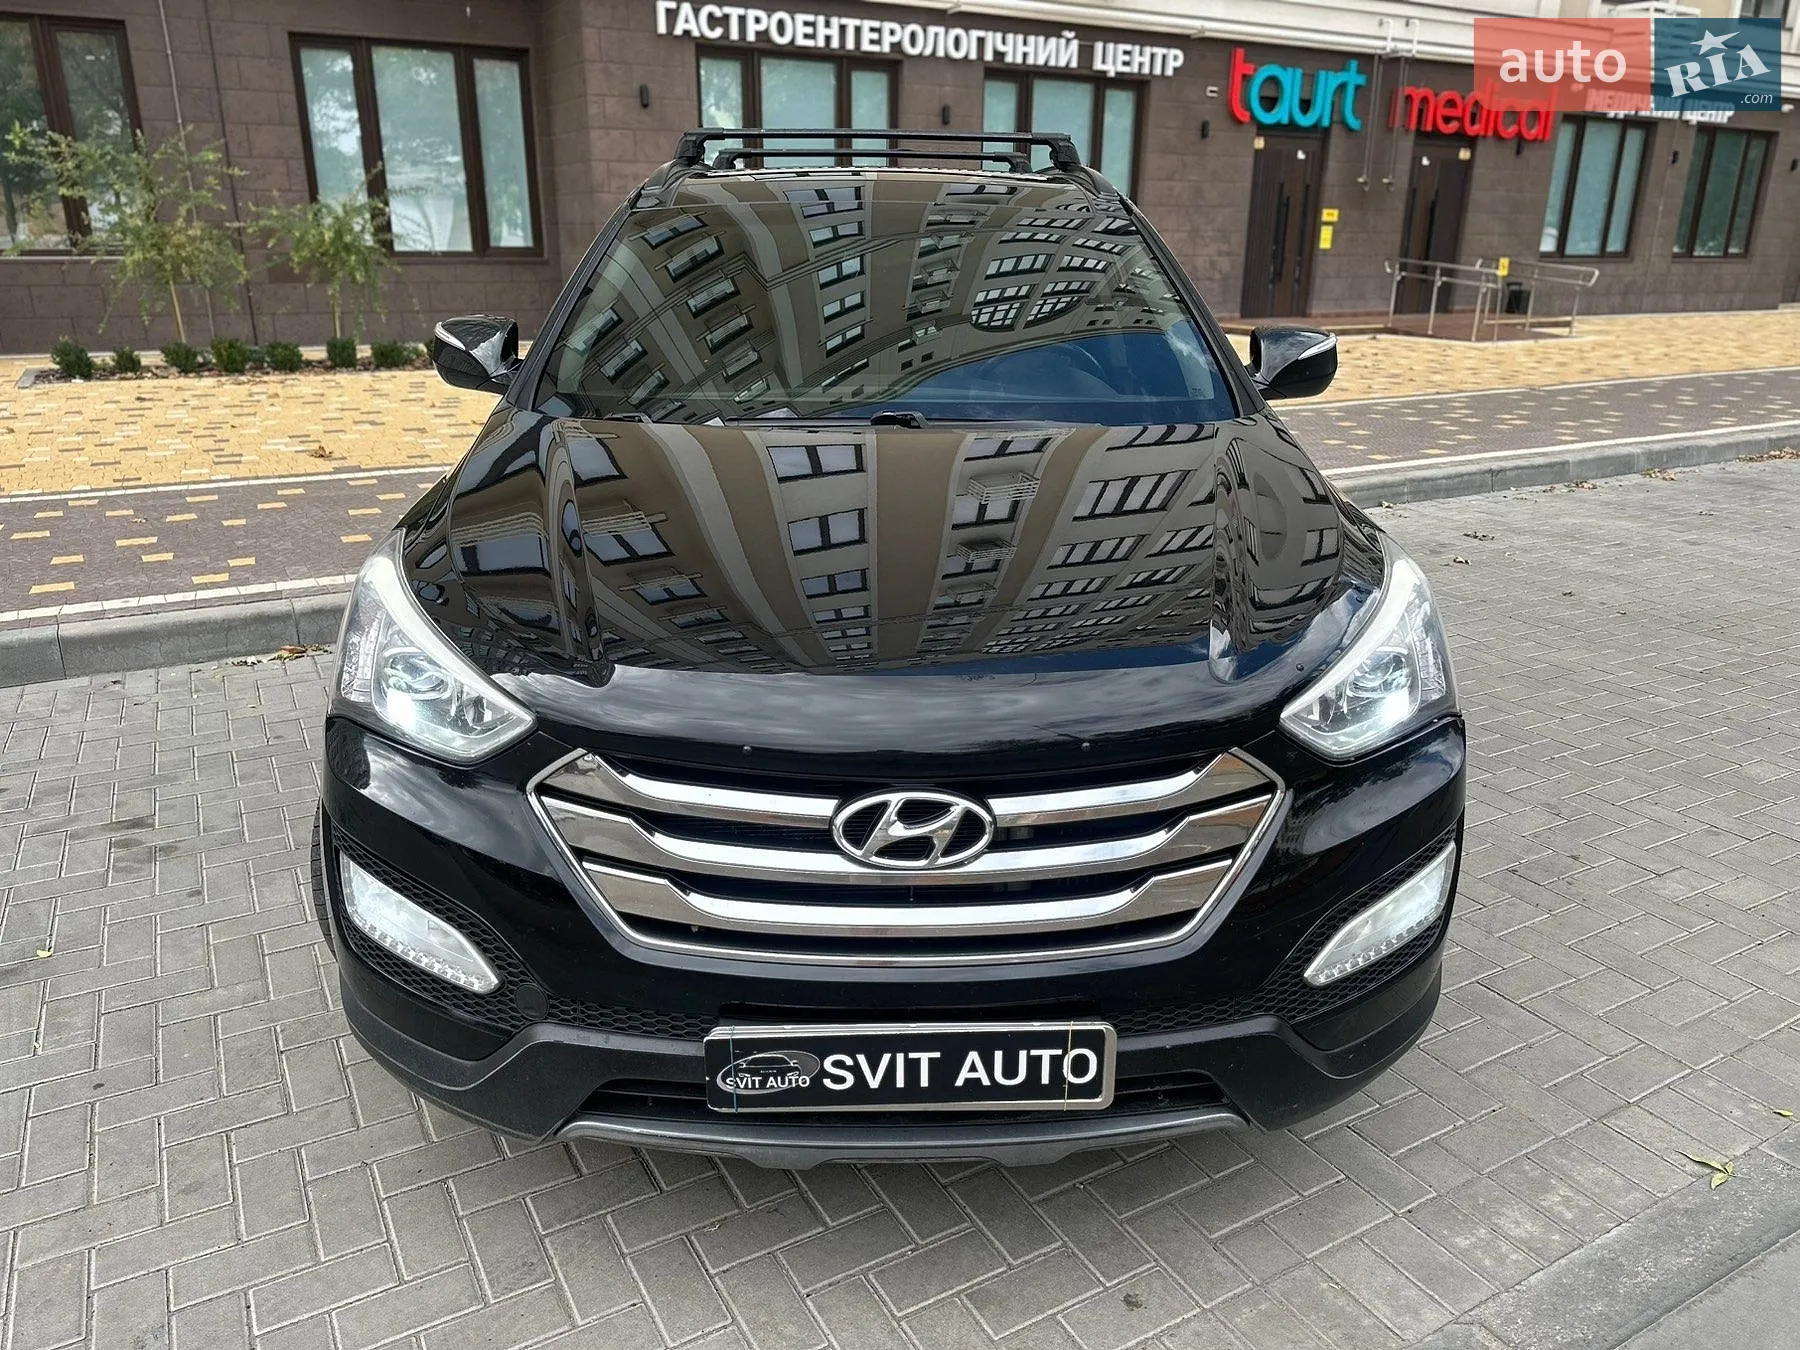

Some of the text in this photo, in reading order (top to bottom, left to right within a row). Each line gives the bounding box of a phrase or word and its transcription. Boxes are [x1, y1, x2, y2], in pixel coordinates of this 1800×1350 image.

[656, 0, 1184, 77] ГАСТРОЕНТЕРОЛОГІЧНИЙ ЦЕНТР
[1229, 47, 1559, 142] taurt medical
[726, 1075, 810, 1089] SVIT AUTO
[822, 1047, 1098, 1090] SVIT AUTO
